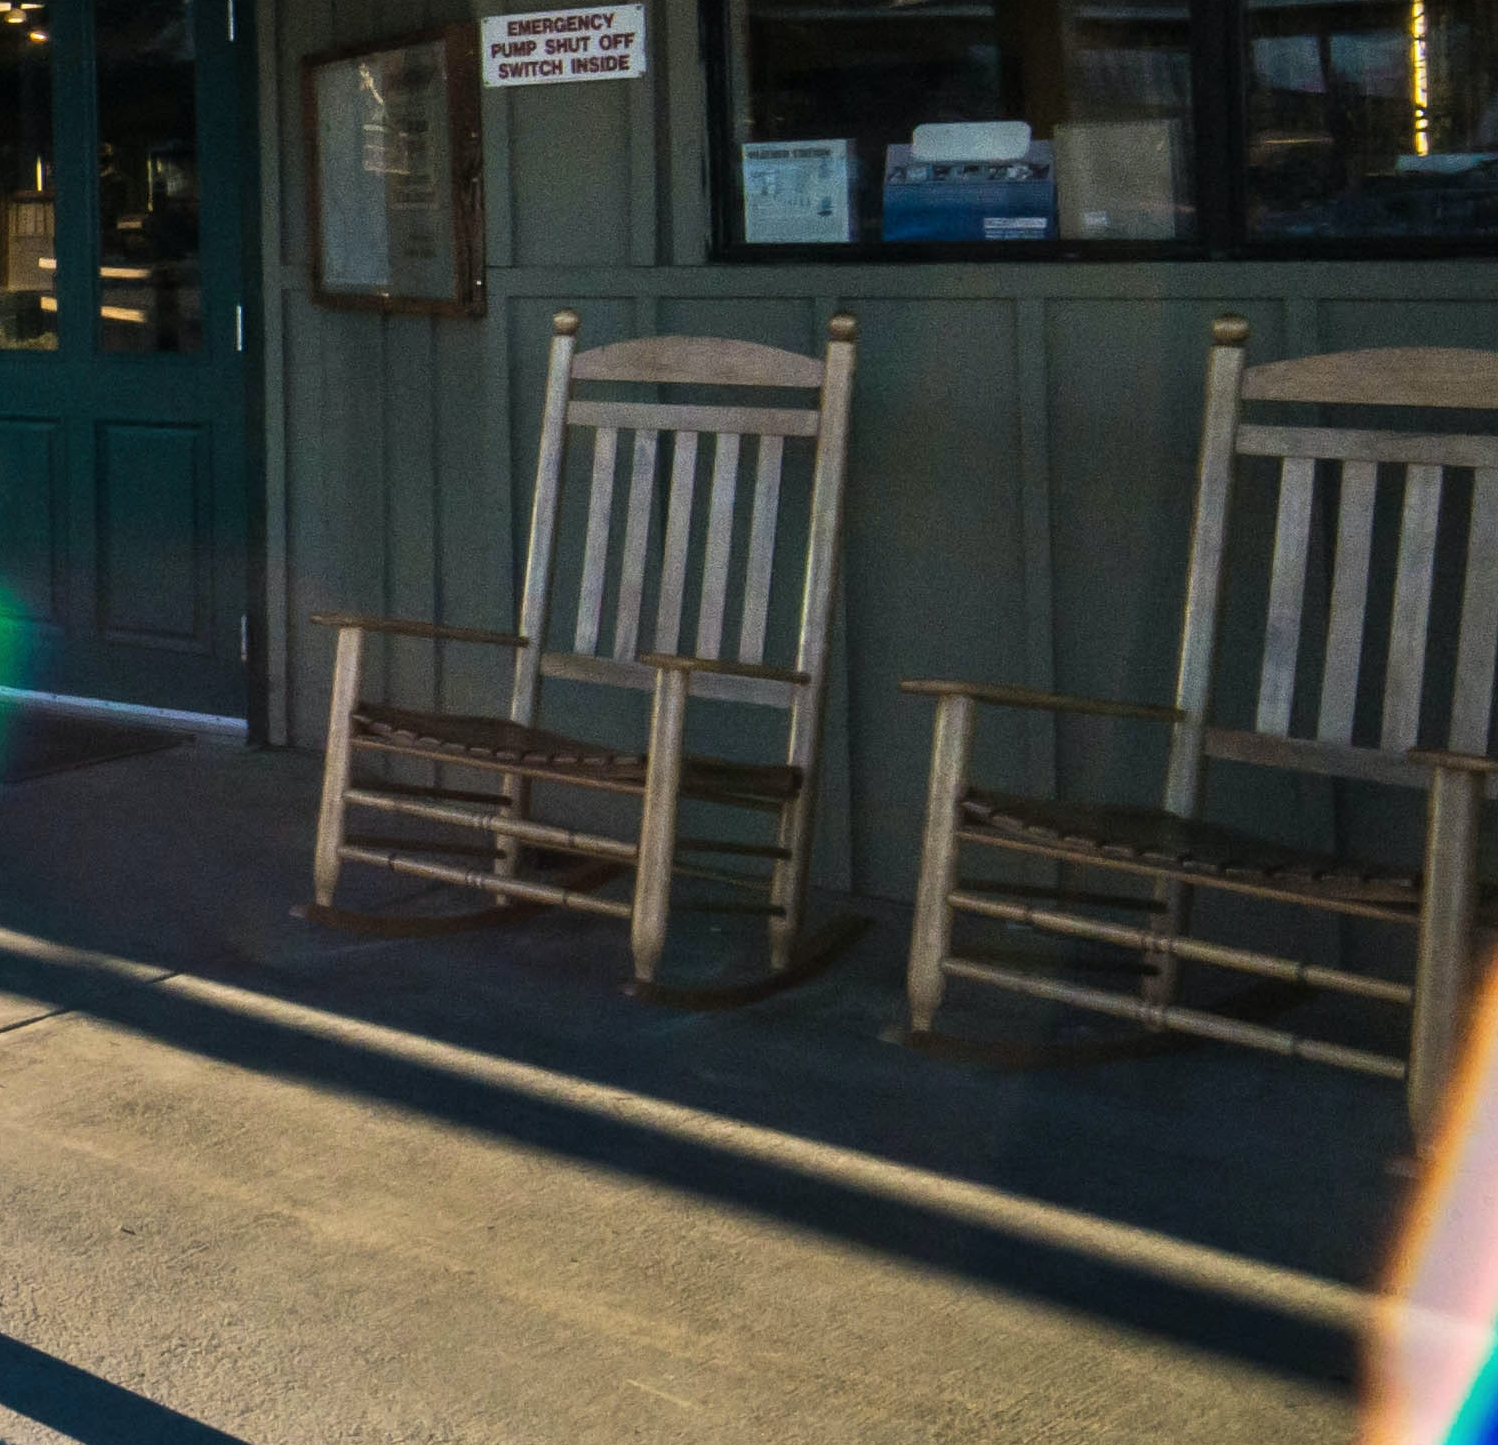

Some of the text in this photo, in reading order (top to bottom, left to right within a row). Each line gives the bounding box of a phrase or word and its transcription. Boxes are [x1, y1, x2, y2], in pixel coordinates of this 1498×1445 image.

[507, 13, 615, 36] EMERGENCY
[491, 33, 635, 58] PUMP SHUT OFF
[499, 55, 630, 79] SWITCH INSIDE
